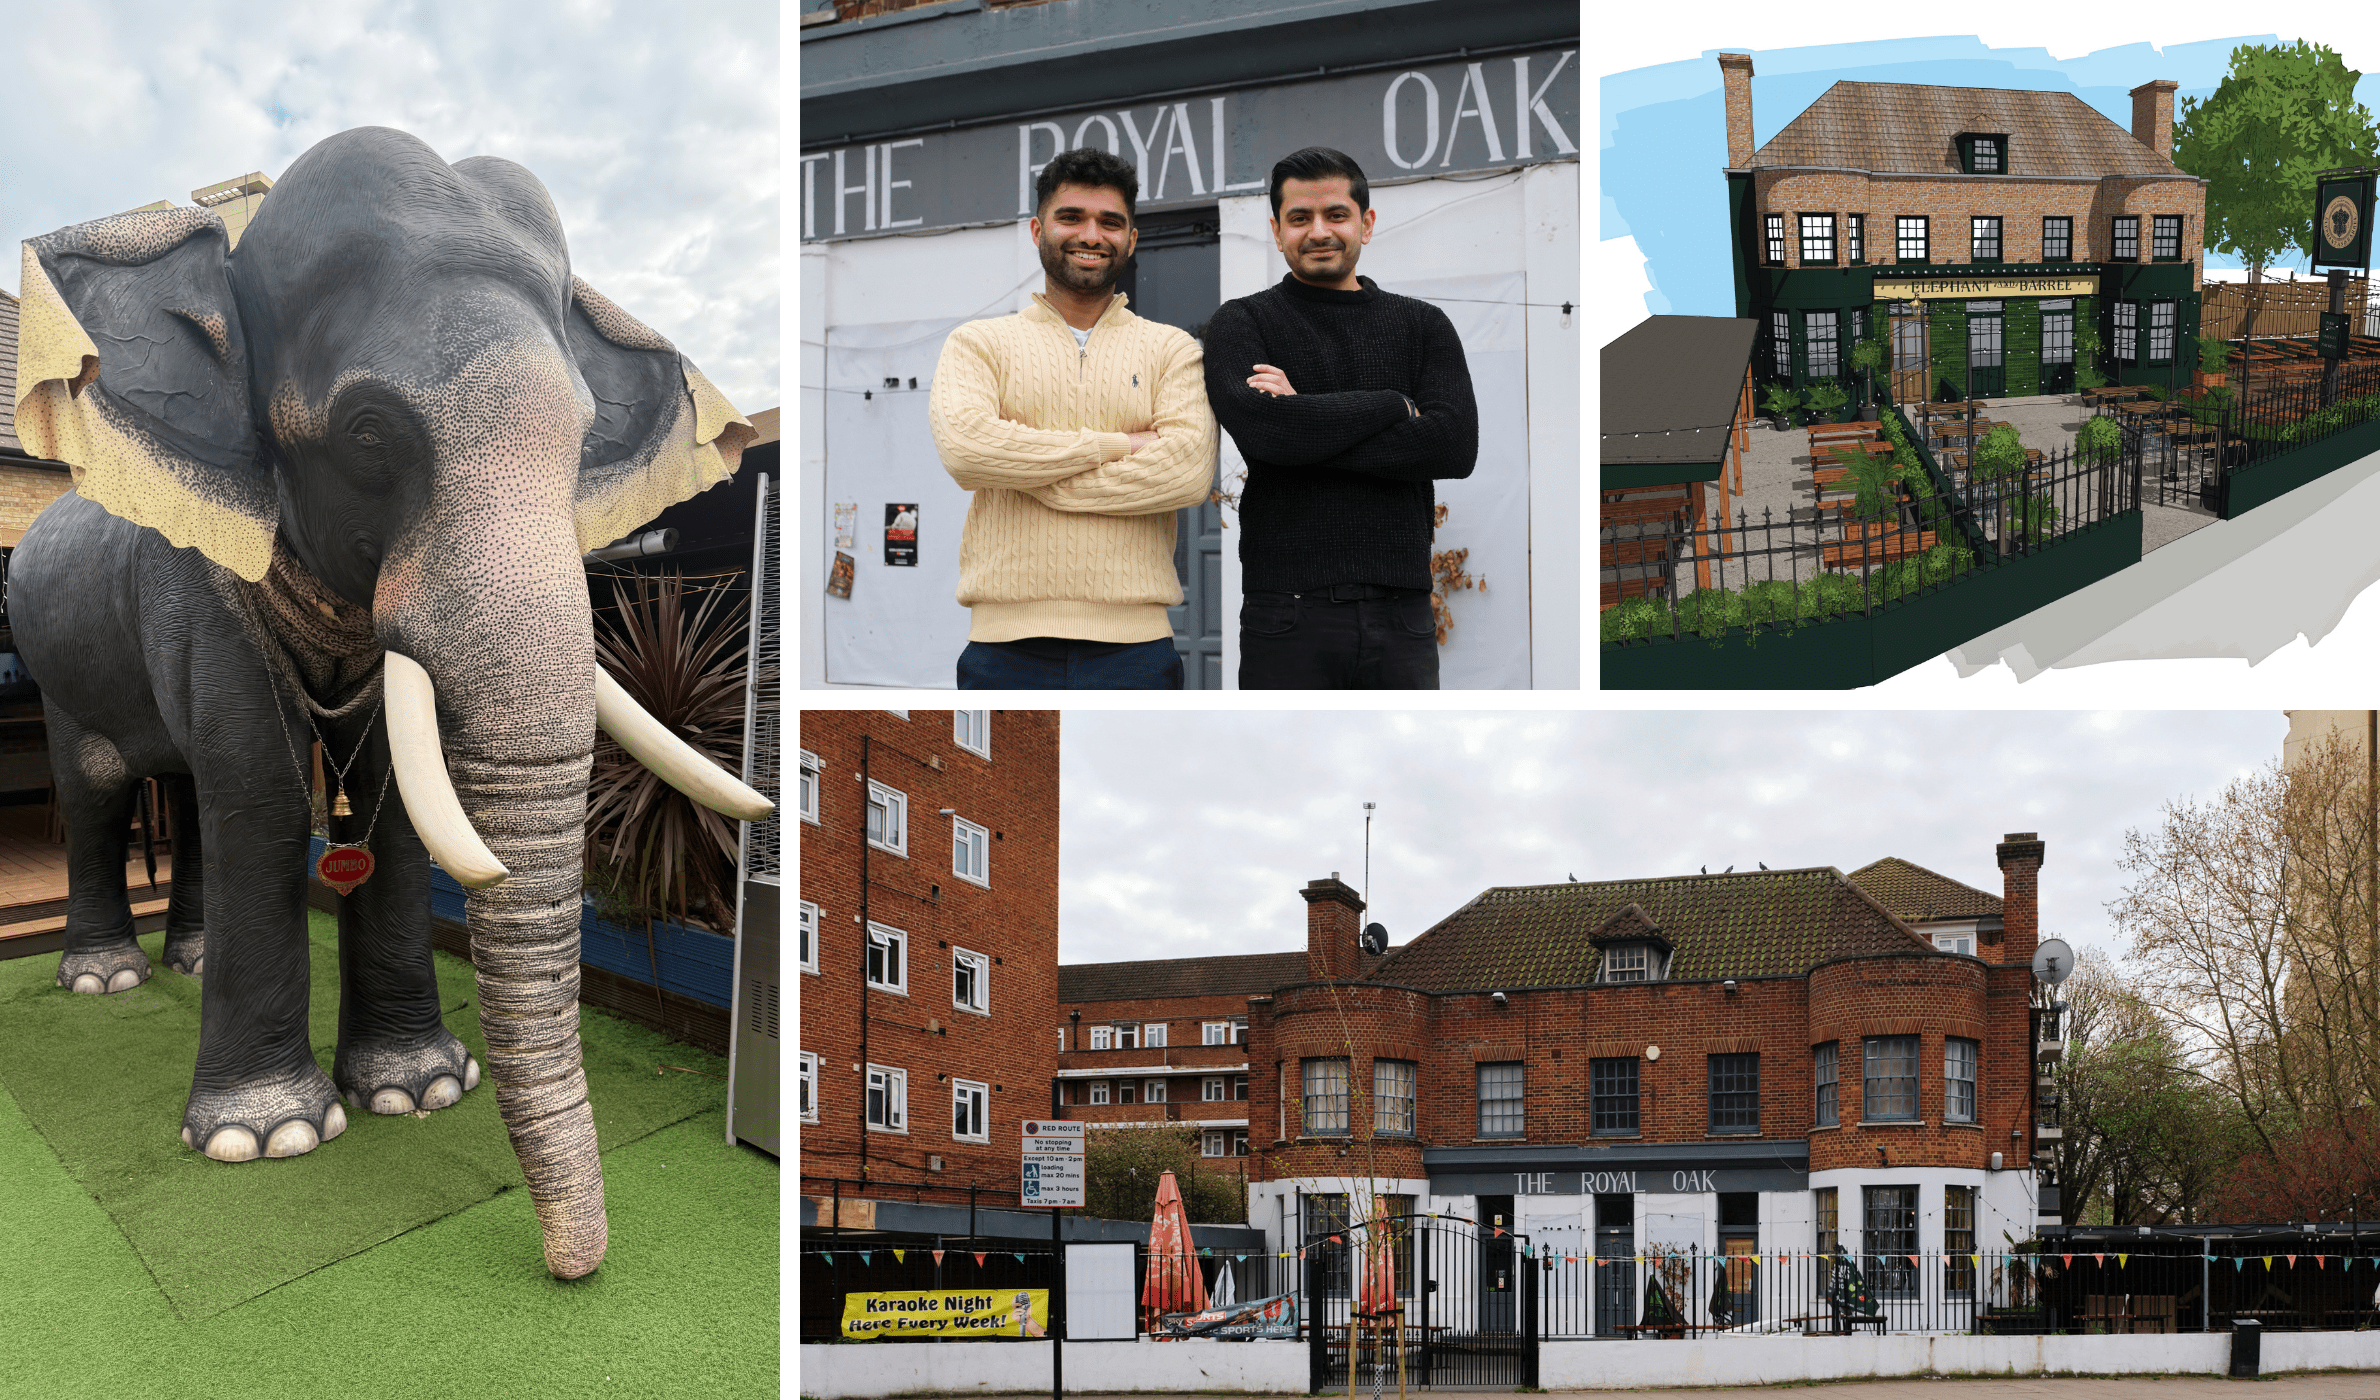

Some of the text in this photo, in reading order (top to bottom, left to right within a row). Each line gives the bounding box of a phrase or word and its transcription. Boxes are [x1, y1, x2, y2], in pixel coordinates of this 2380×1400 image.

[800, 138, 924, 240] THE
[1383, 49, 1580, 170] OAK
[1911, 279, 2072, 293] ELEPHANT AND BARREL
[325, 858, 366, 873] JUMBO
[1514, 1169, 1717, 1194] THE ROYAL OAK
[866, 1295, 993, 1314] Karaoke Night
[849, 1314, 1008, 1332] Here Every Week!
[1220, 1323, 1264, 1335] SPORTS
[1266, 1324, 1293, 1333] HERE
